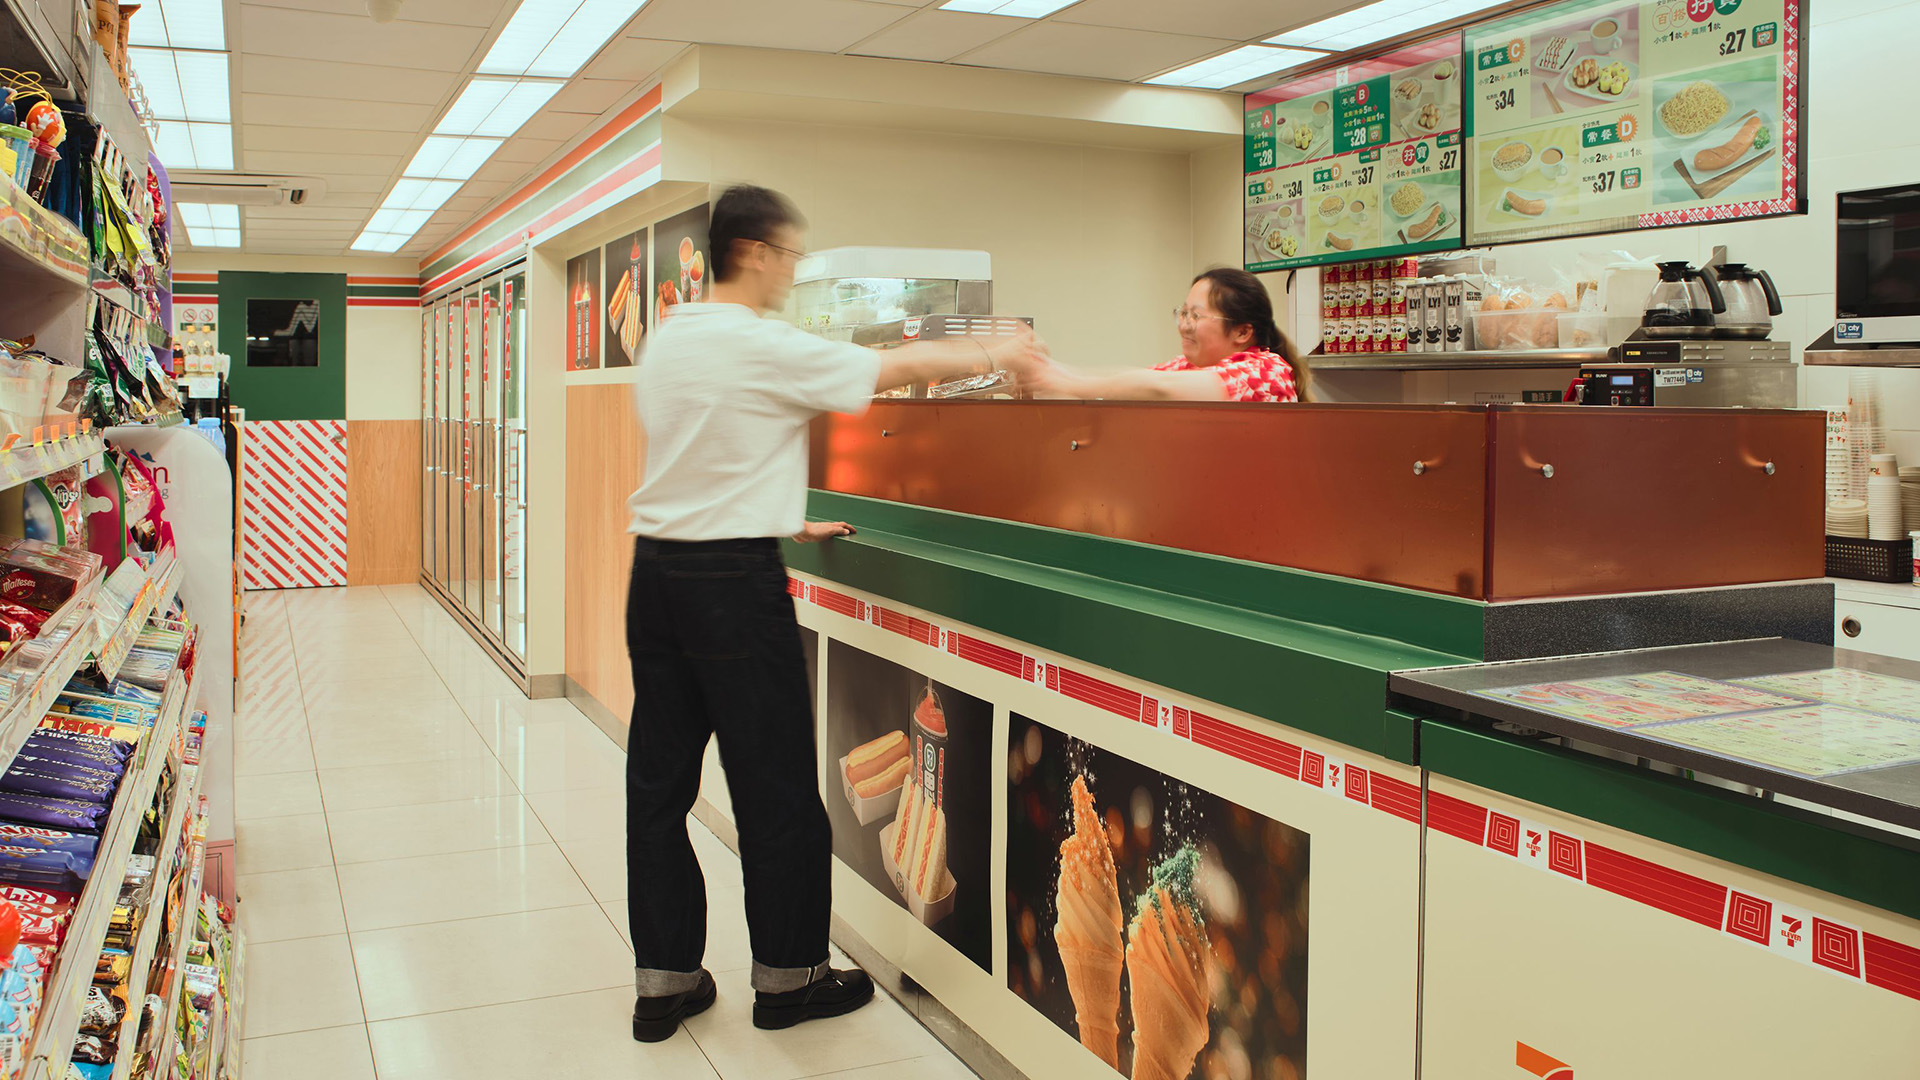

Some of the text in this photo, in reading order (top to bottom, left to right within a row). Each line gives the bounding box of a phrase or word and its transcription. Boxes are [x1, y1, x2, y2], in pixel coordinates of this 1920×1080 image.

[1511, 43, 1521, 58] C
[1720, 28, 1746, 56] $27
[1359, 89, 1366, 100] B
[1495, 88, 1515, 111] $34
[1264, 115, 1270, 125] A
[1351, 127, 1366, 147] $28
[1587, 121, 1632, 143] 常餐 D
[1259, 149, 1273, 167] $28
[1440, 150, 1457, 170] $27
[1333, 167, 1339, 178] D
[1358, 166, 1374, 185] $37
[1593, 170, 1615, 194] $37
[1288, 180, 1302, 198] $34
[1409, 299, 1420, 309] LY!
[1428, 297, 1441, 308] LY!
[1448, 295, 1460, 306] LY!
[1037, 664, 1044, 681] 7
[1161, 706, 1170, 727] 7
[1329, 763, 1340, 787] 7
[1526, 829, 1541, 857] 7
[1781, 914, 1802, 948] 7
